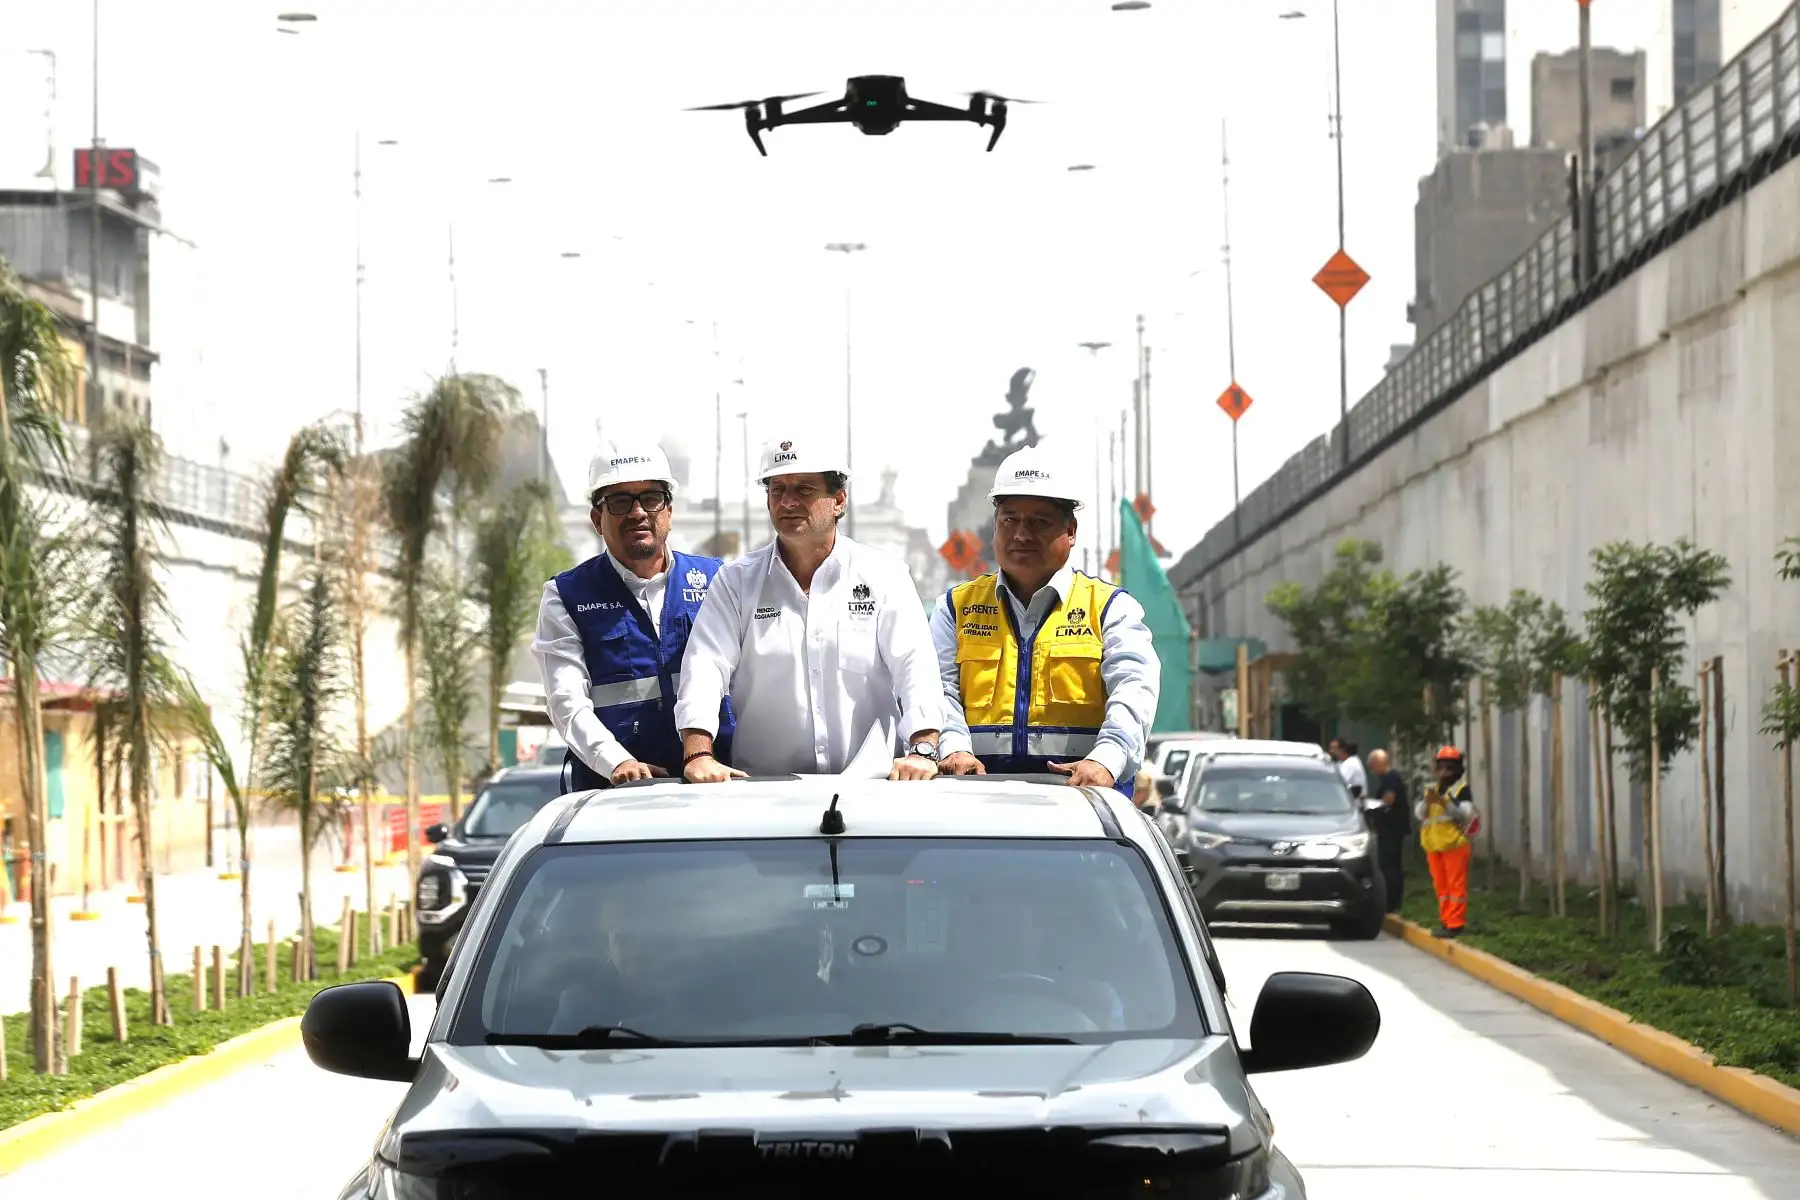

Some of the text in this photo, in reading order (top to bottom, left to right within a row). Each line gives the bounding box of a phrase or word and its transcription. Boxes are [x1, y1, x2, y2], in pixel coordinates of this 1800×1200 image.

[610, 456, 640, 467] EMAPE
[774, 453, 797, 463] LIMA
[1014, 470, 1040, 478] EMAPE
[683, 591, 707, 602] LIM
[577, 602, 609, 612] EMAPE
[848, 603, 875, 611] LIMA
[962, 604, 999, 616] GERENTE
[961, 622, 998, 631] MOVILIDAD
[963, 629, 992, 637] URBANA
[1055, 627, 1093, 637] LIMA
[757, 1142, 856, 1161] TRITON
